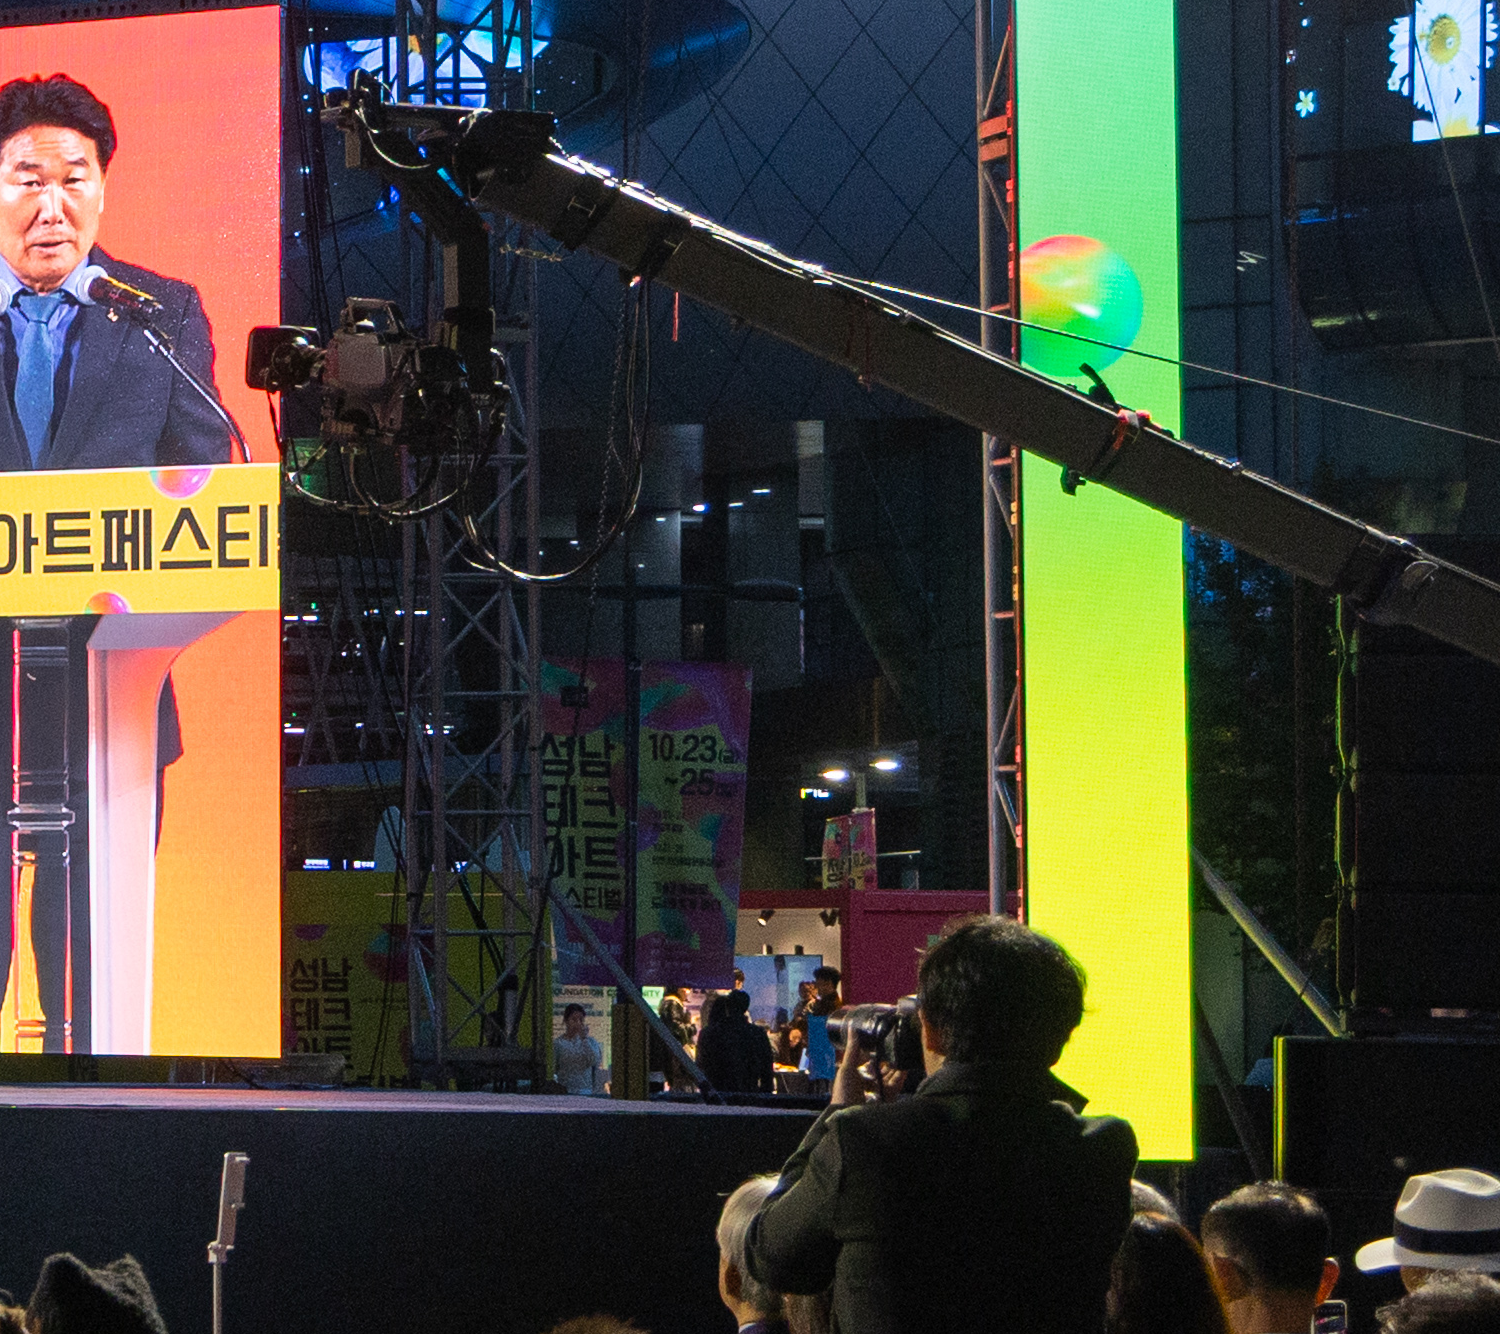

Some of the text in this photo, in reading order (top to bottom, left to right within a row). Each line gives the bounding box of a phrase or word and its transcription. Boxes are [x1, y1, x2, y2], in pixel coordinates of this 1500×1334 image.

[564, 886, 623, 911] 스티벌
[290, 957, 353, 993] 성남
[290, 997, 353, 1032] 테크
